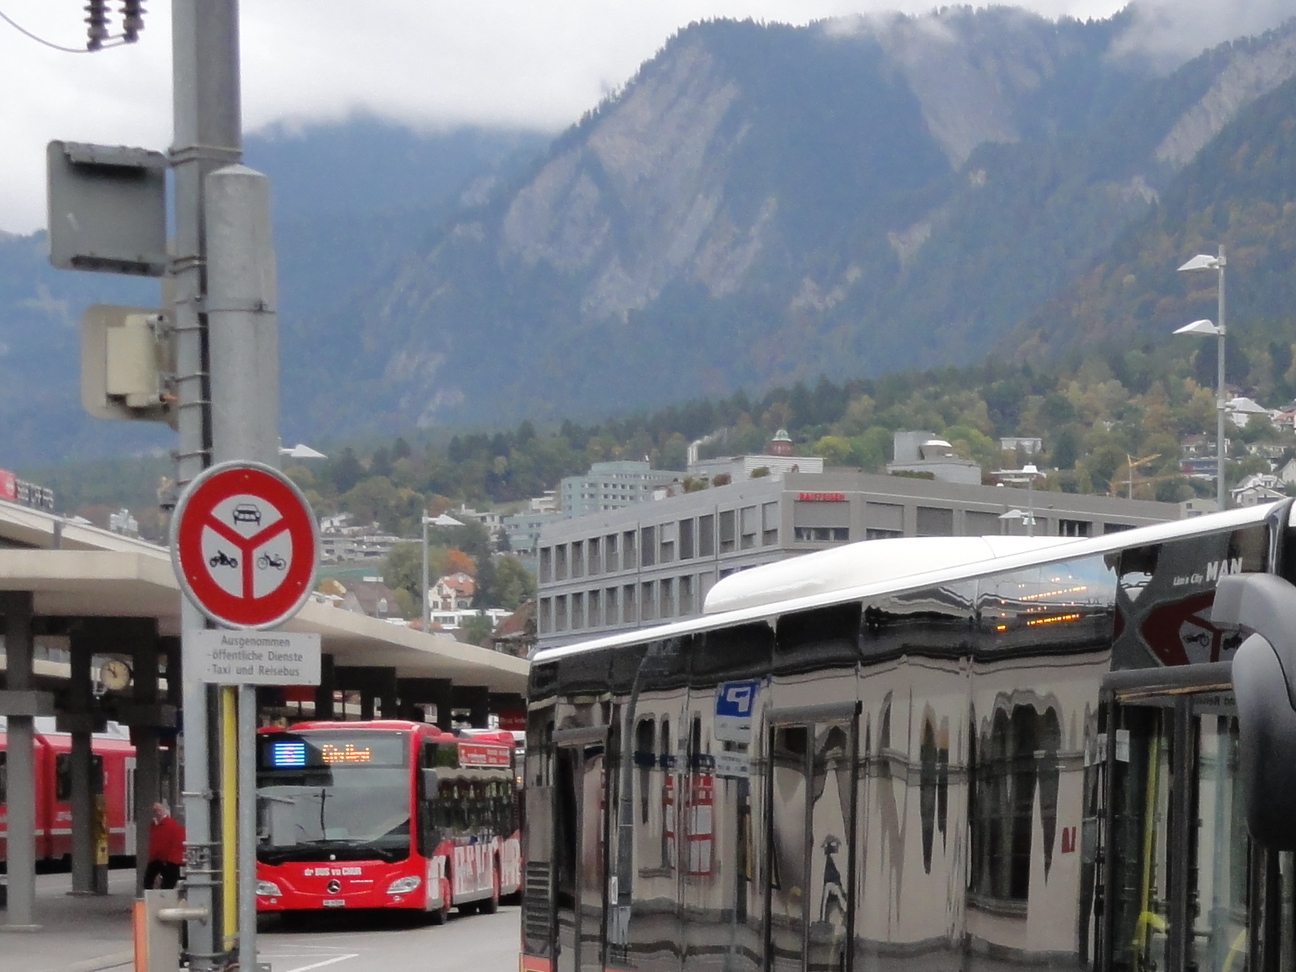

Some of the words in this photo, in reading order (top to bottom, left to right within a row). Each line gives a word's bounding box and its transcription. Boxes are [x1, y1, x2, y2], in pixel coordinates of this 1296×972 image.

[1206, 557, 1243, 582] MAN
[221, 635, 291, 648] Ausgenommen
[268, 651, 304, 662] Dienste
[236, 665, 254, 676] und
[259, 666, 300, 676] Reisebus
